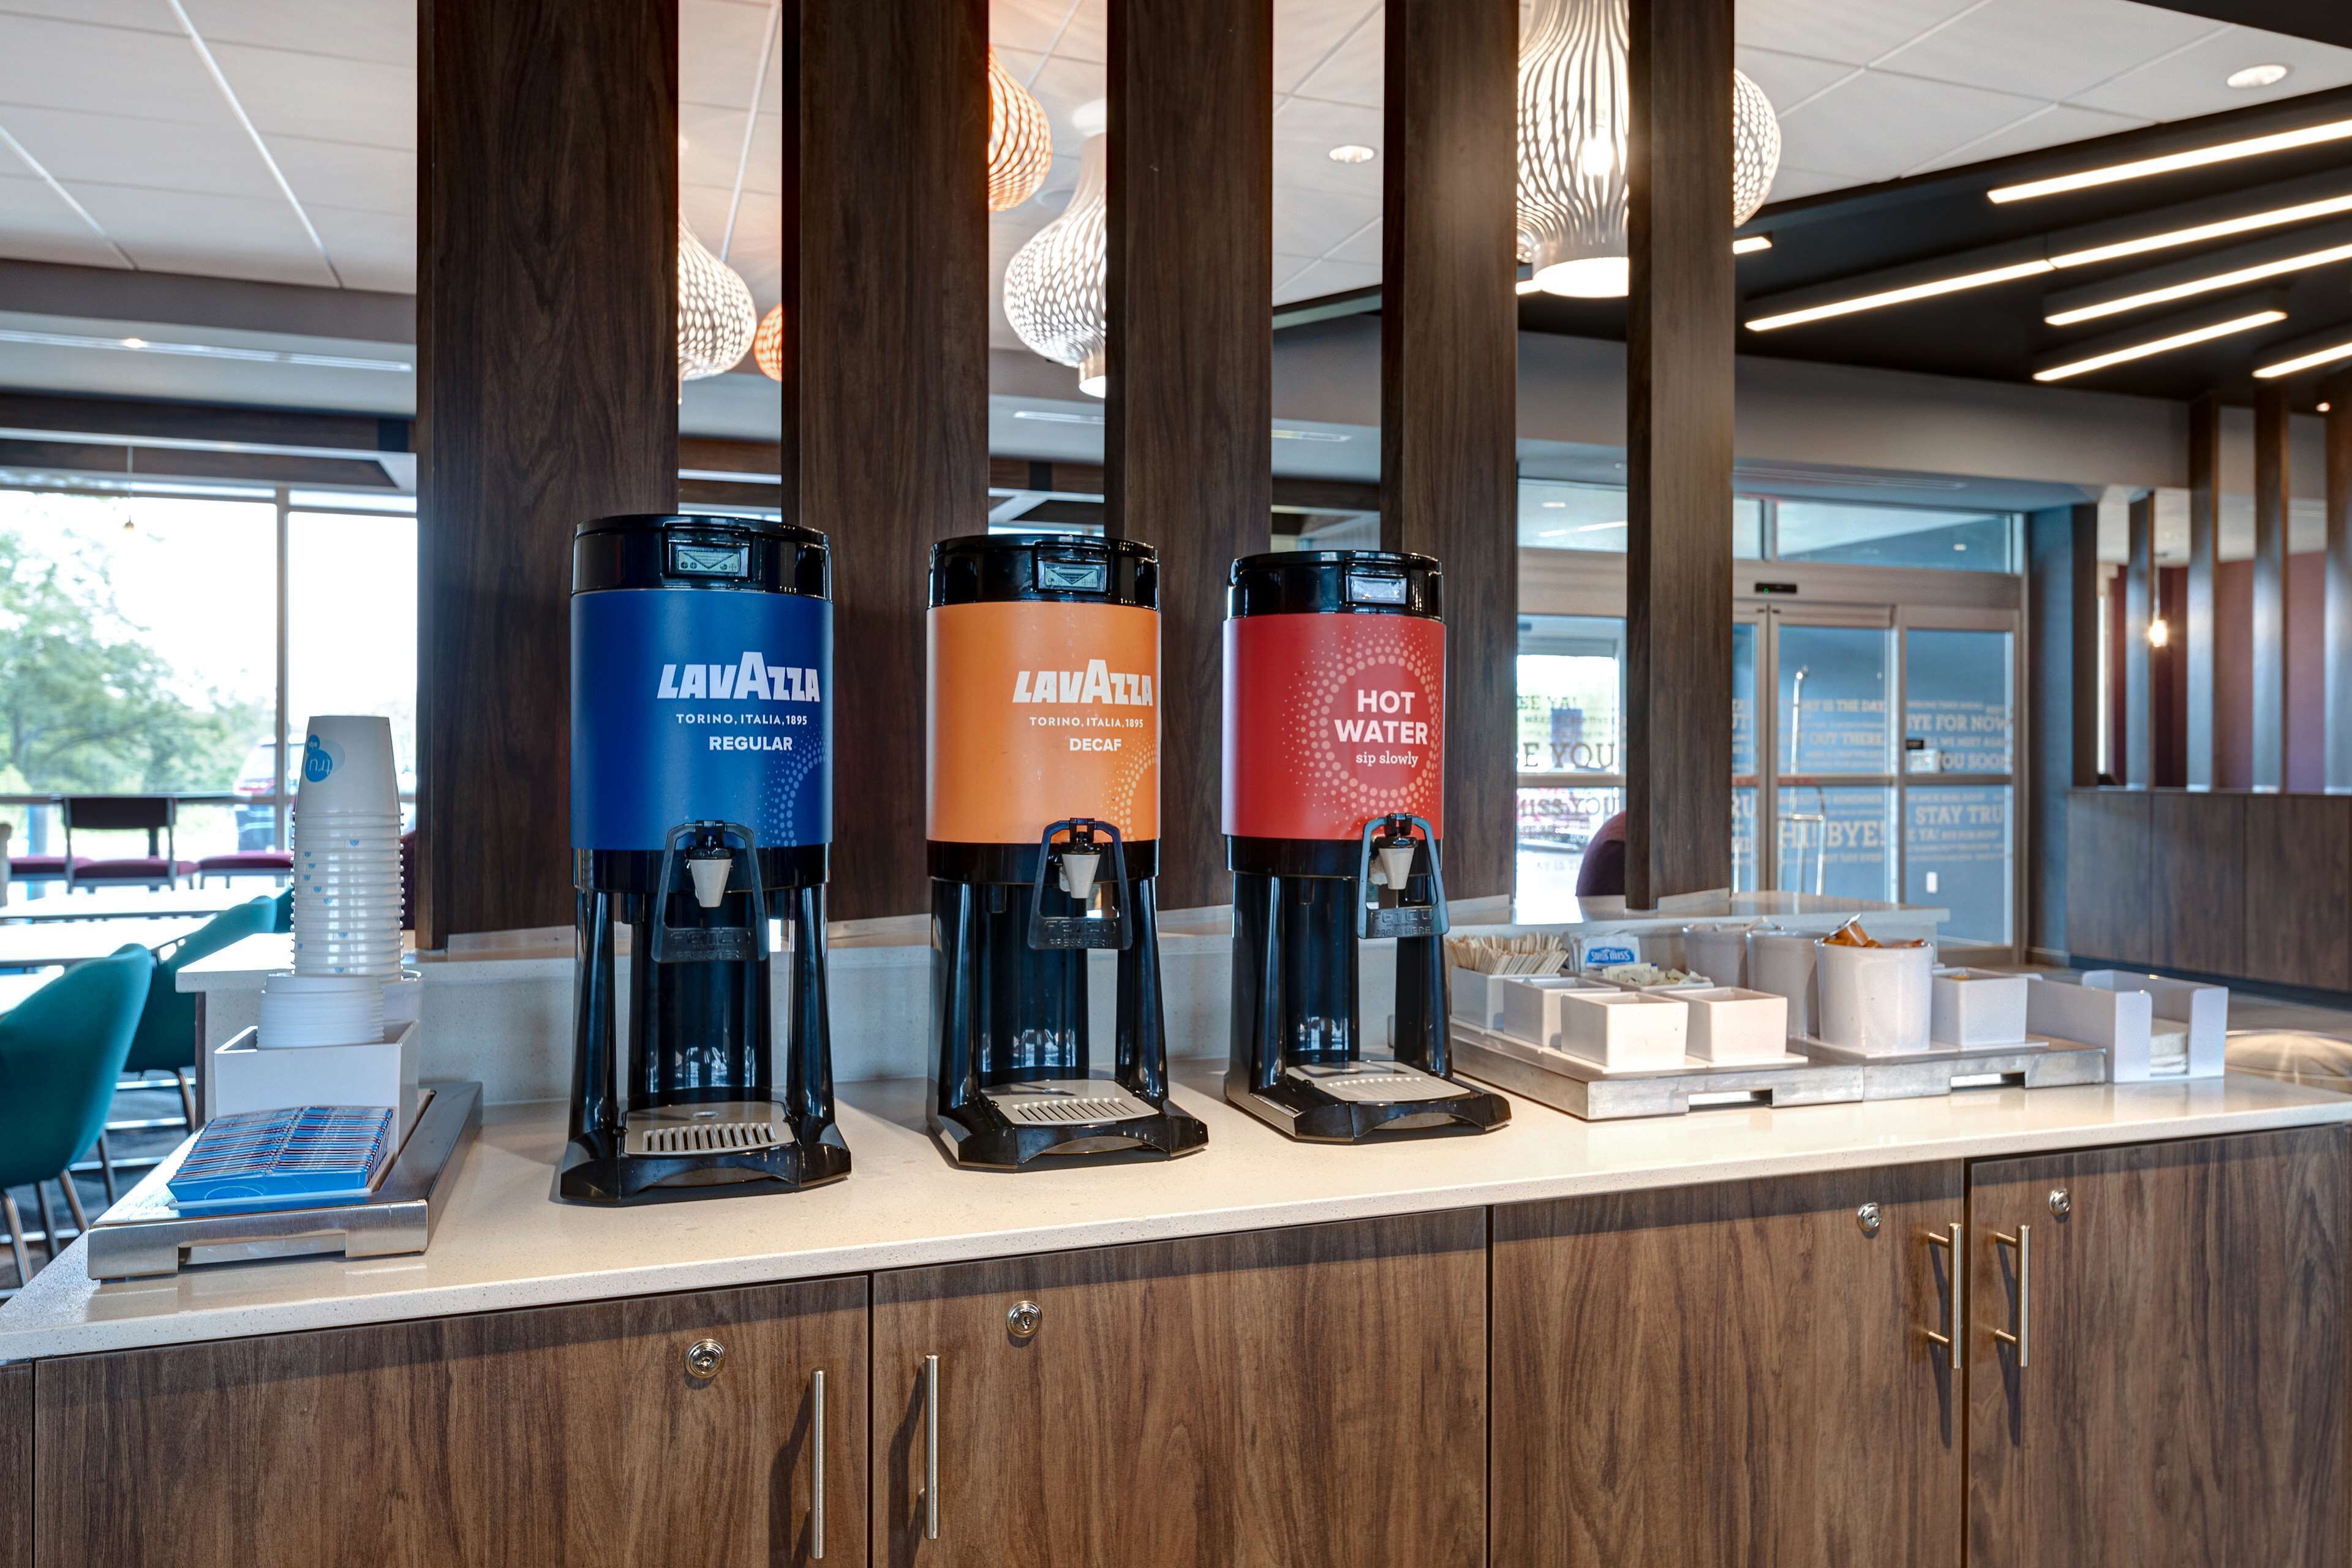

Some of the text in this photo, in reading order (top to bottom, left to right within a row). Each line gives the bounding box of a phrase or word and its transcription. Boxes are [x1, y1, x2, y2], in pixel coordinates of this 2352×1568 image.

[657, 651, 820, 703] LAVAZZA
[1012, 658, 1153, 706] LAVAZZA
[1357, 689, 1415, 714] HOT
[676, 713, 807, 726] TORINO, ITALIA, 1895
[1030, 717, 1144, 728] TORINO, ITALIA, 1895
[1936, 714, 1967, 732] FOR
[1333, 719, 1428, 745] WATER
[709, 736, 793, 752] REGULAR
[1069, 738, 1122, 752] DECAF
[1355, 750, 1419, 768] sip slowly
[1550, 742, 1615, 769] YOU
[309, 758, 331, 775] tru
[1915, 805, 1963, 824] STAY
